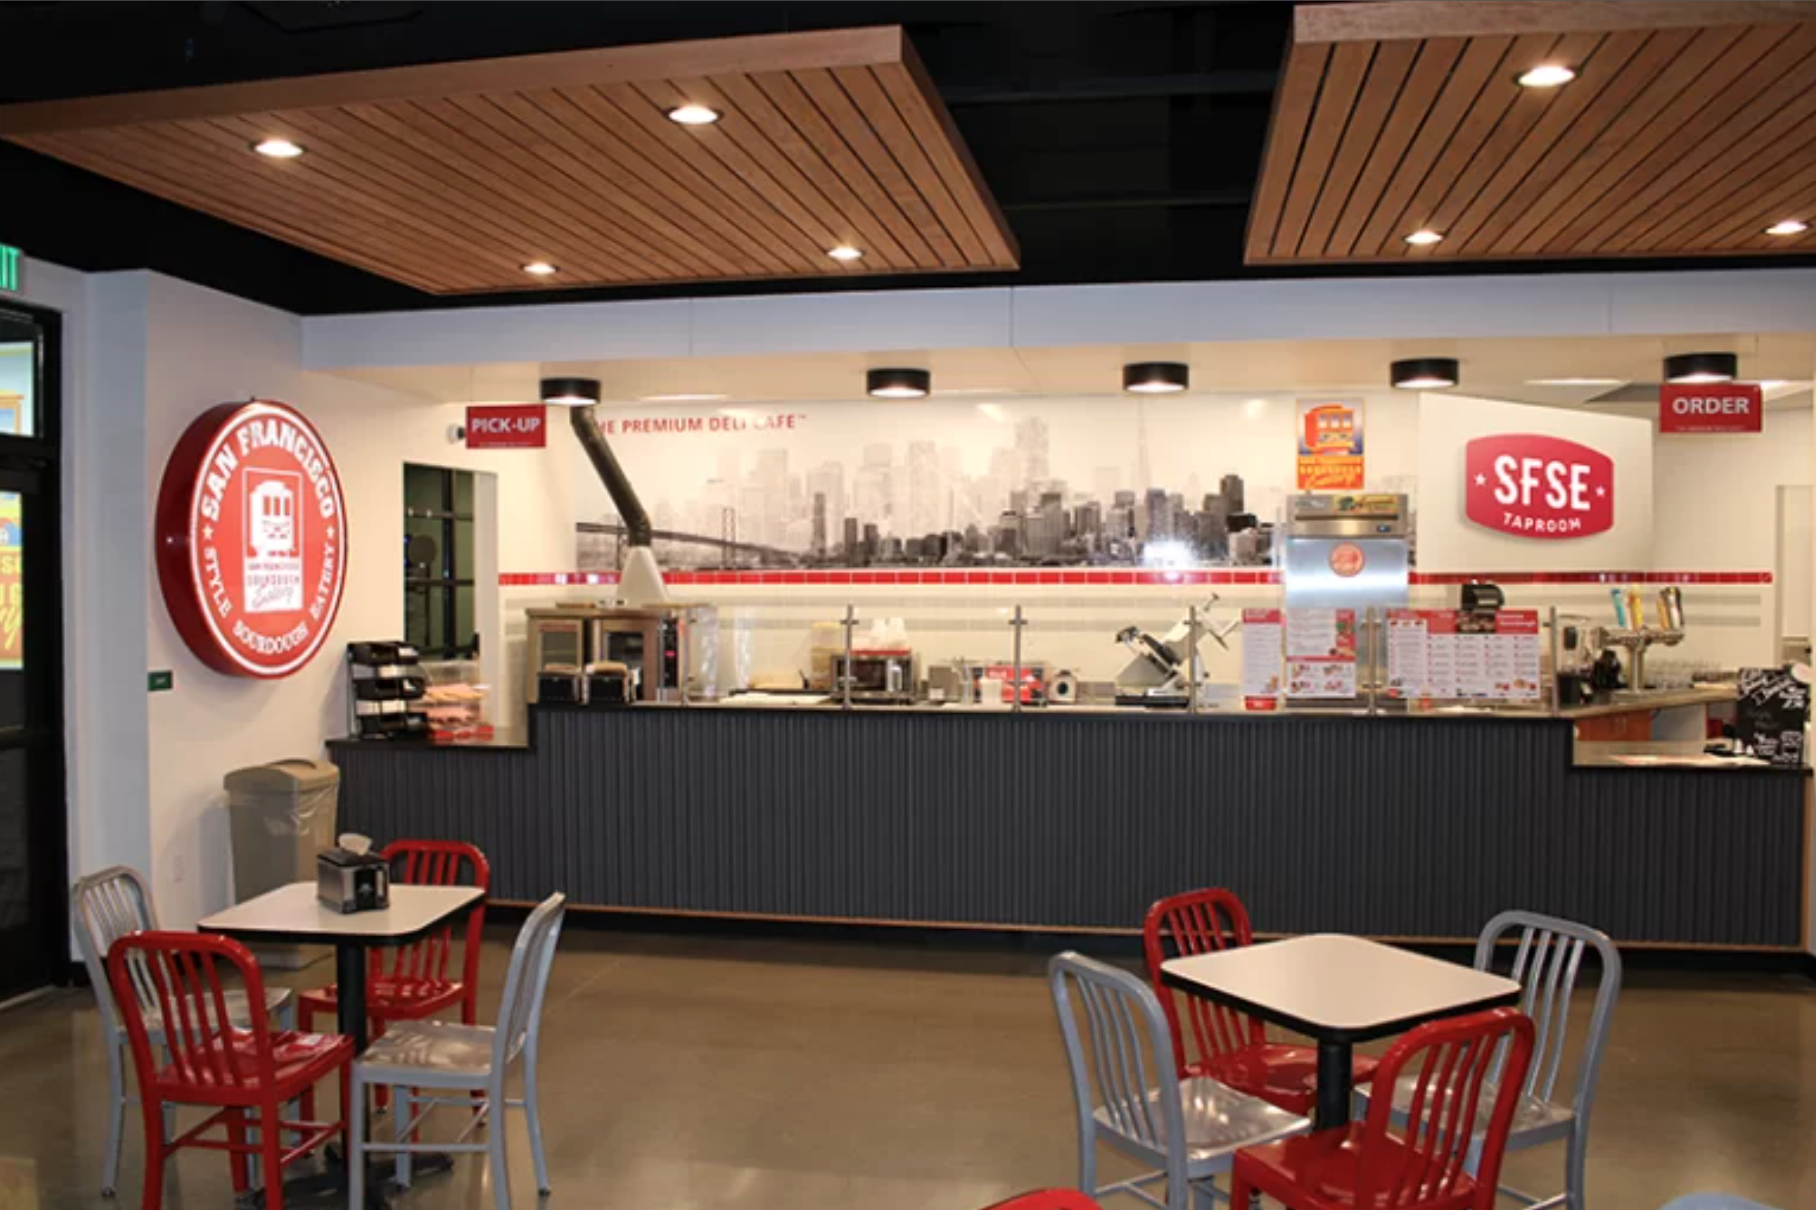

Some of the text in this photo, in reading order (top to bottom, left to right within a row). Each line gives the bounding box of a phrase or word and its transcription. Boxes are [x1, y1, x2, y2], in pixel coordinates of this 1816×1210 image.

[0, 243, 20, 291] IT
[1672, 396, 1750, 415] ORDER
[471, 416, 542, 434] PICK-UP
[595, 420, 614, 435] HE
[621, 417, 703, 433] PREMIUM
[201, 419, 335, 522] SAN FRANCISCO
[1493, 454, 1591, 511] SFSE
[1503, 512, 1581, 533] TAPROOM
[204, 542, 335, 655] STYLE SOURDOUGH EATERY
